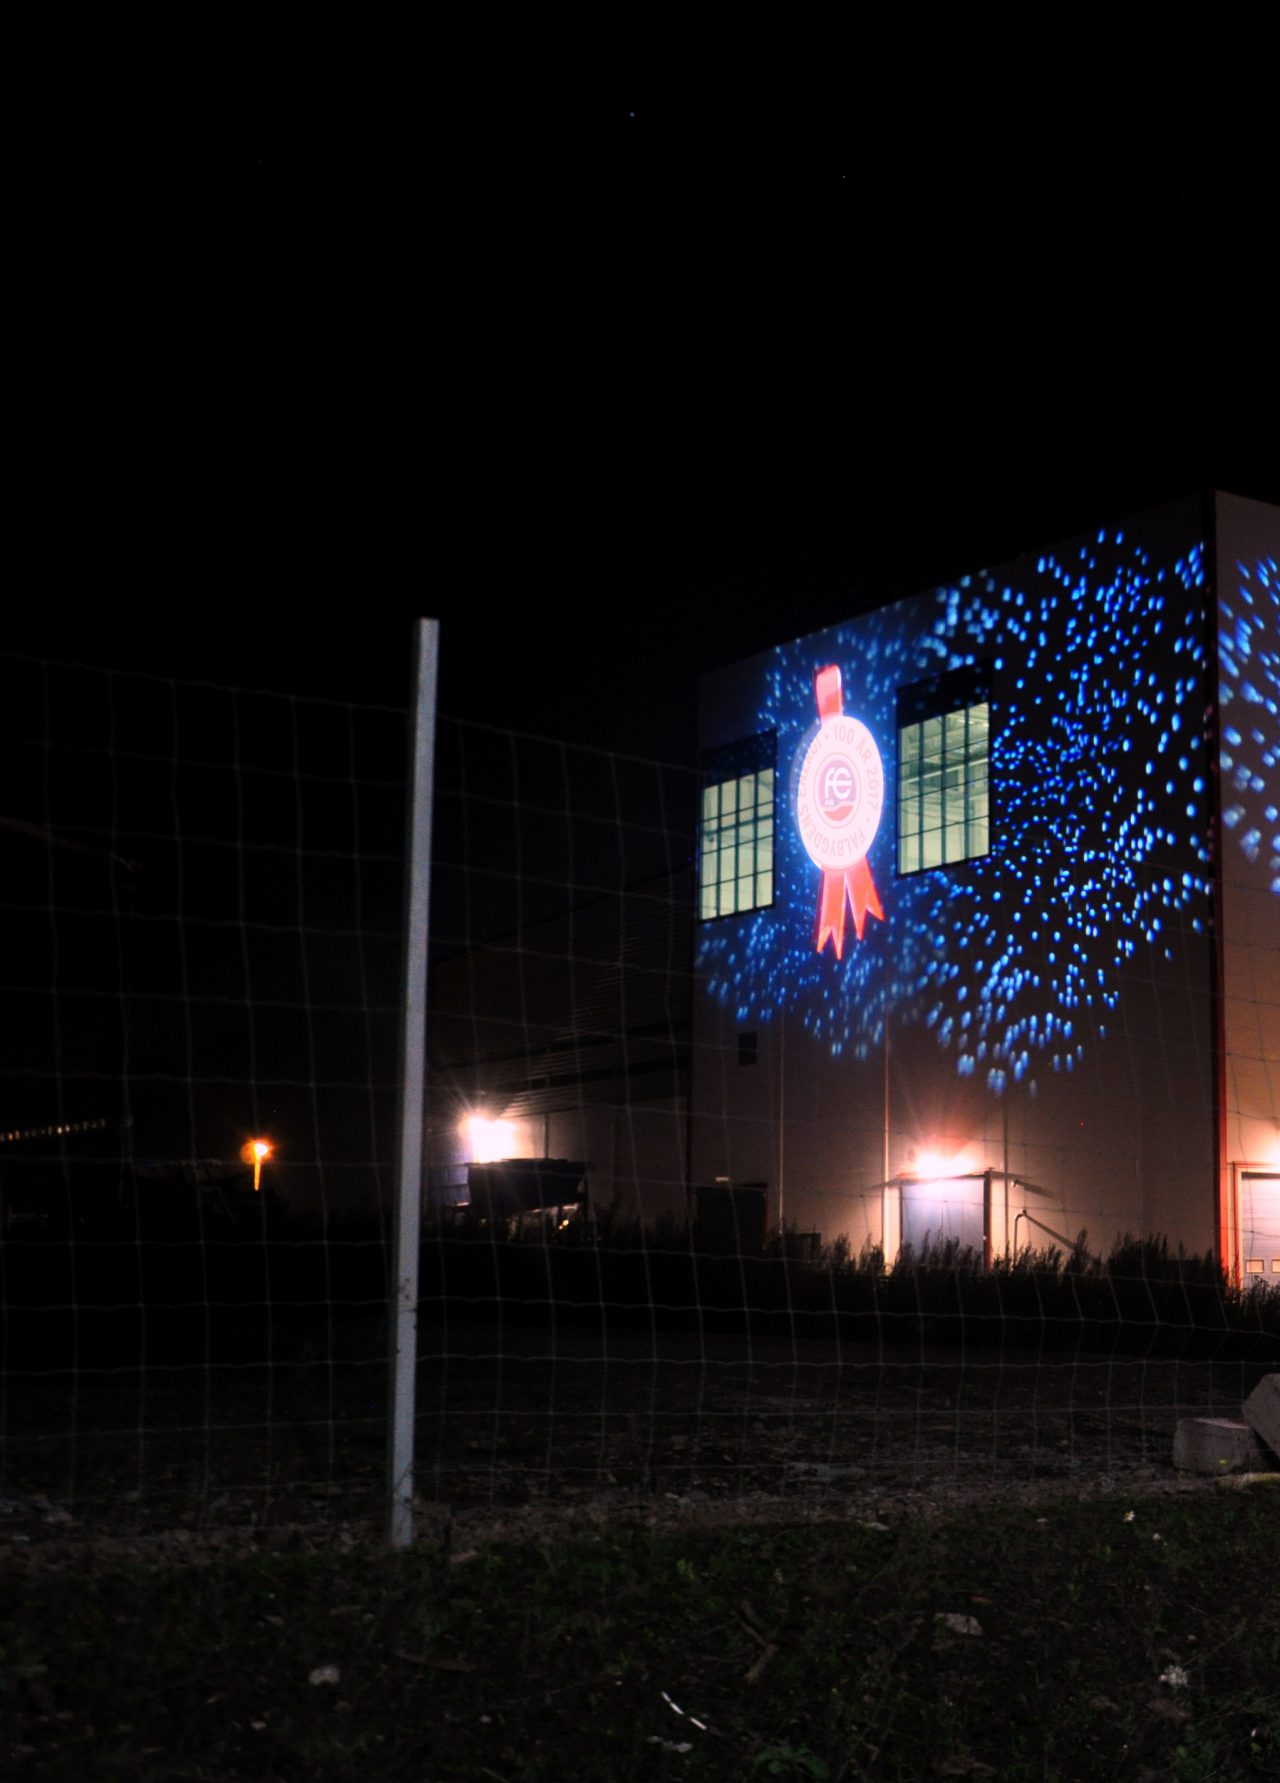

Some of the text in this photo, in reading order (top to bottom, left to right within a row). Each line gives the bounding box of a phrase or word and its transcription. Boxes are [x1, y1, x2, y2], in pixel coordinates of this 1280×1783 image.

[834, 724, 880, 812] 100 ÅR 2017
[799, 804, 866, 857] FALBYGDENS
